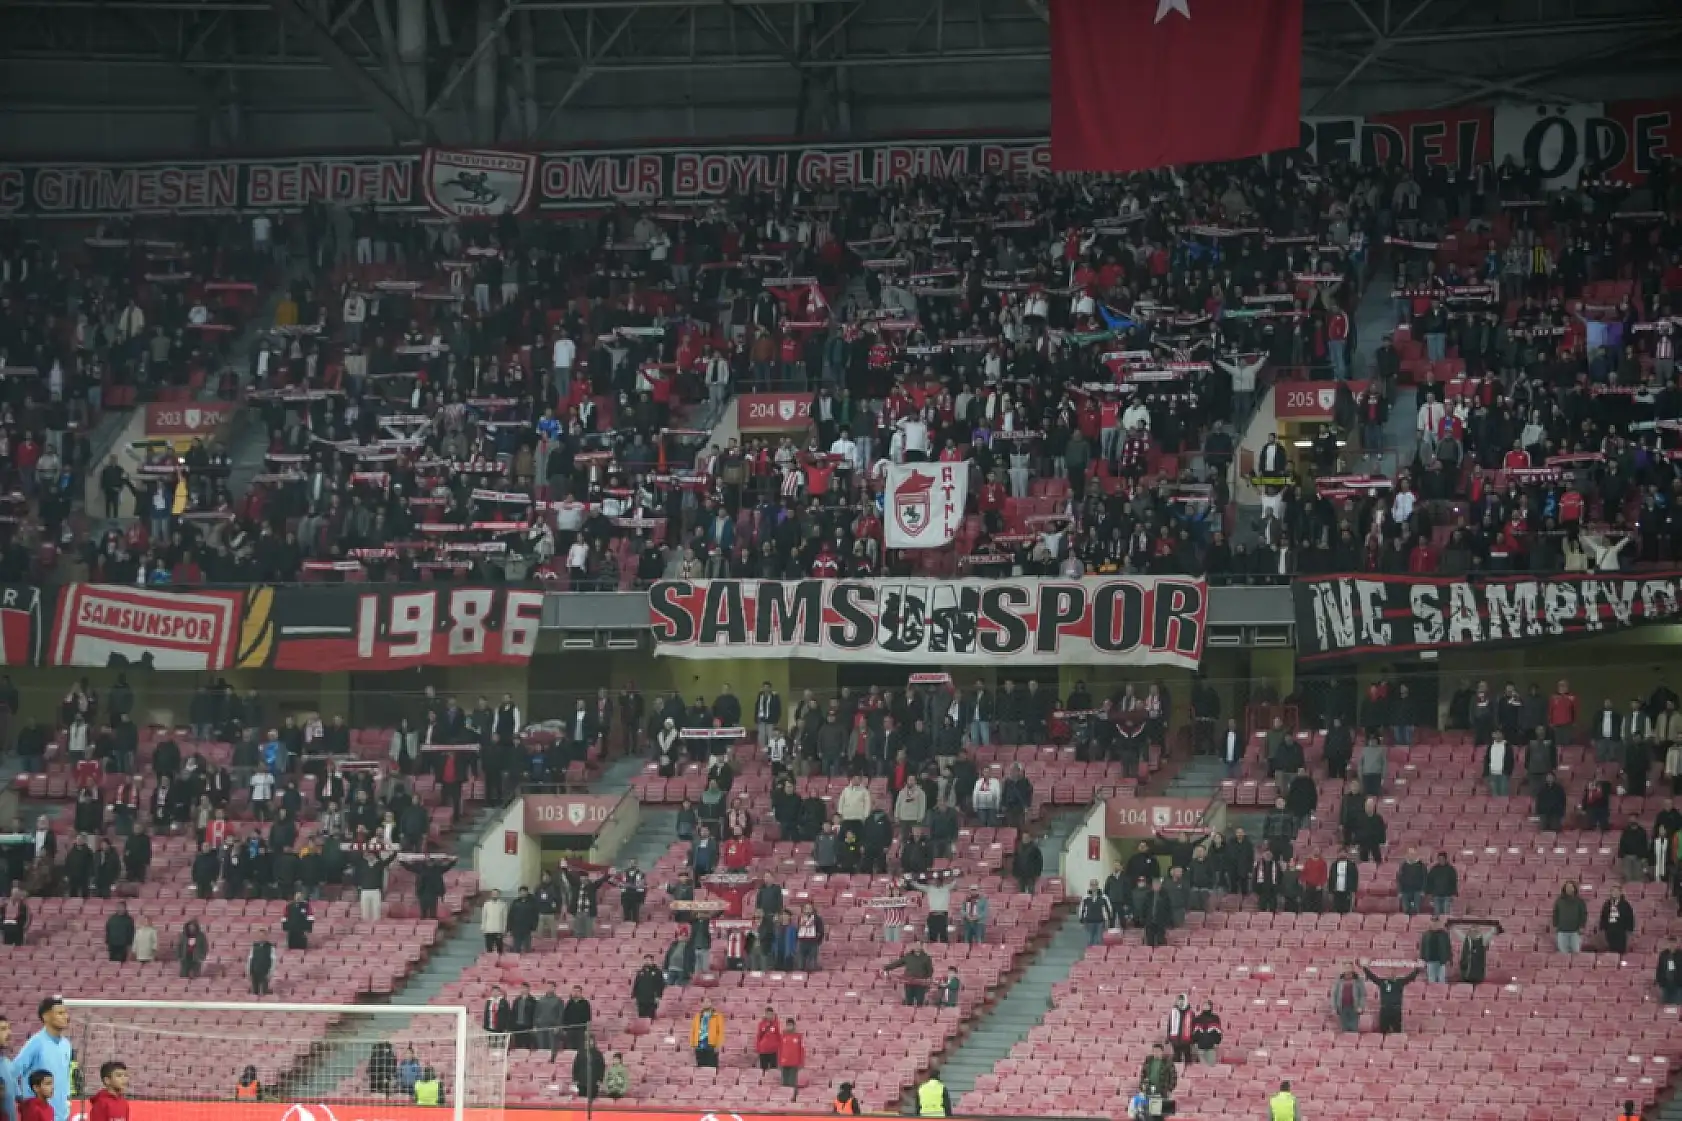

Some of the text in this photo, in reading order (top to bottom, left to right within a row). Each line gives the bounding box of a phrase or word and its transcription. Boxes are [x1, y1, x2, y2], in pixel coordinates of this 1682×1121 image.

[1523, 104, 1673, 178] ÖDE
[248, 161, 411, 204] BENDEN
[673, 152, 788, 197] BOYU
[156, 411, 181, 426] 203
[749, 403, 775, 418] 204
[1287, 391, 1314, 408] 205
[81, 602, 212, 641] SAMSUNSPOR
[357, 588, 545, 657] 1986
[649, 578, 1203, 657] SAMSUNSPOR
[1309, 577, 1392, 651] NE
[536, 805, 564, 821] 103
[1119, 808, 1147, 826] 104
